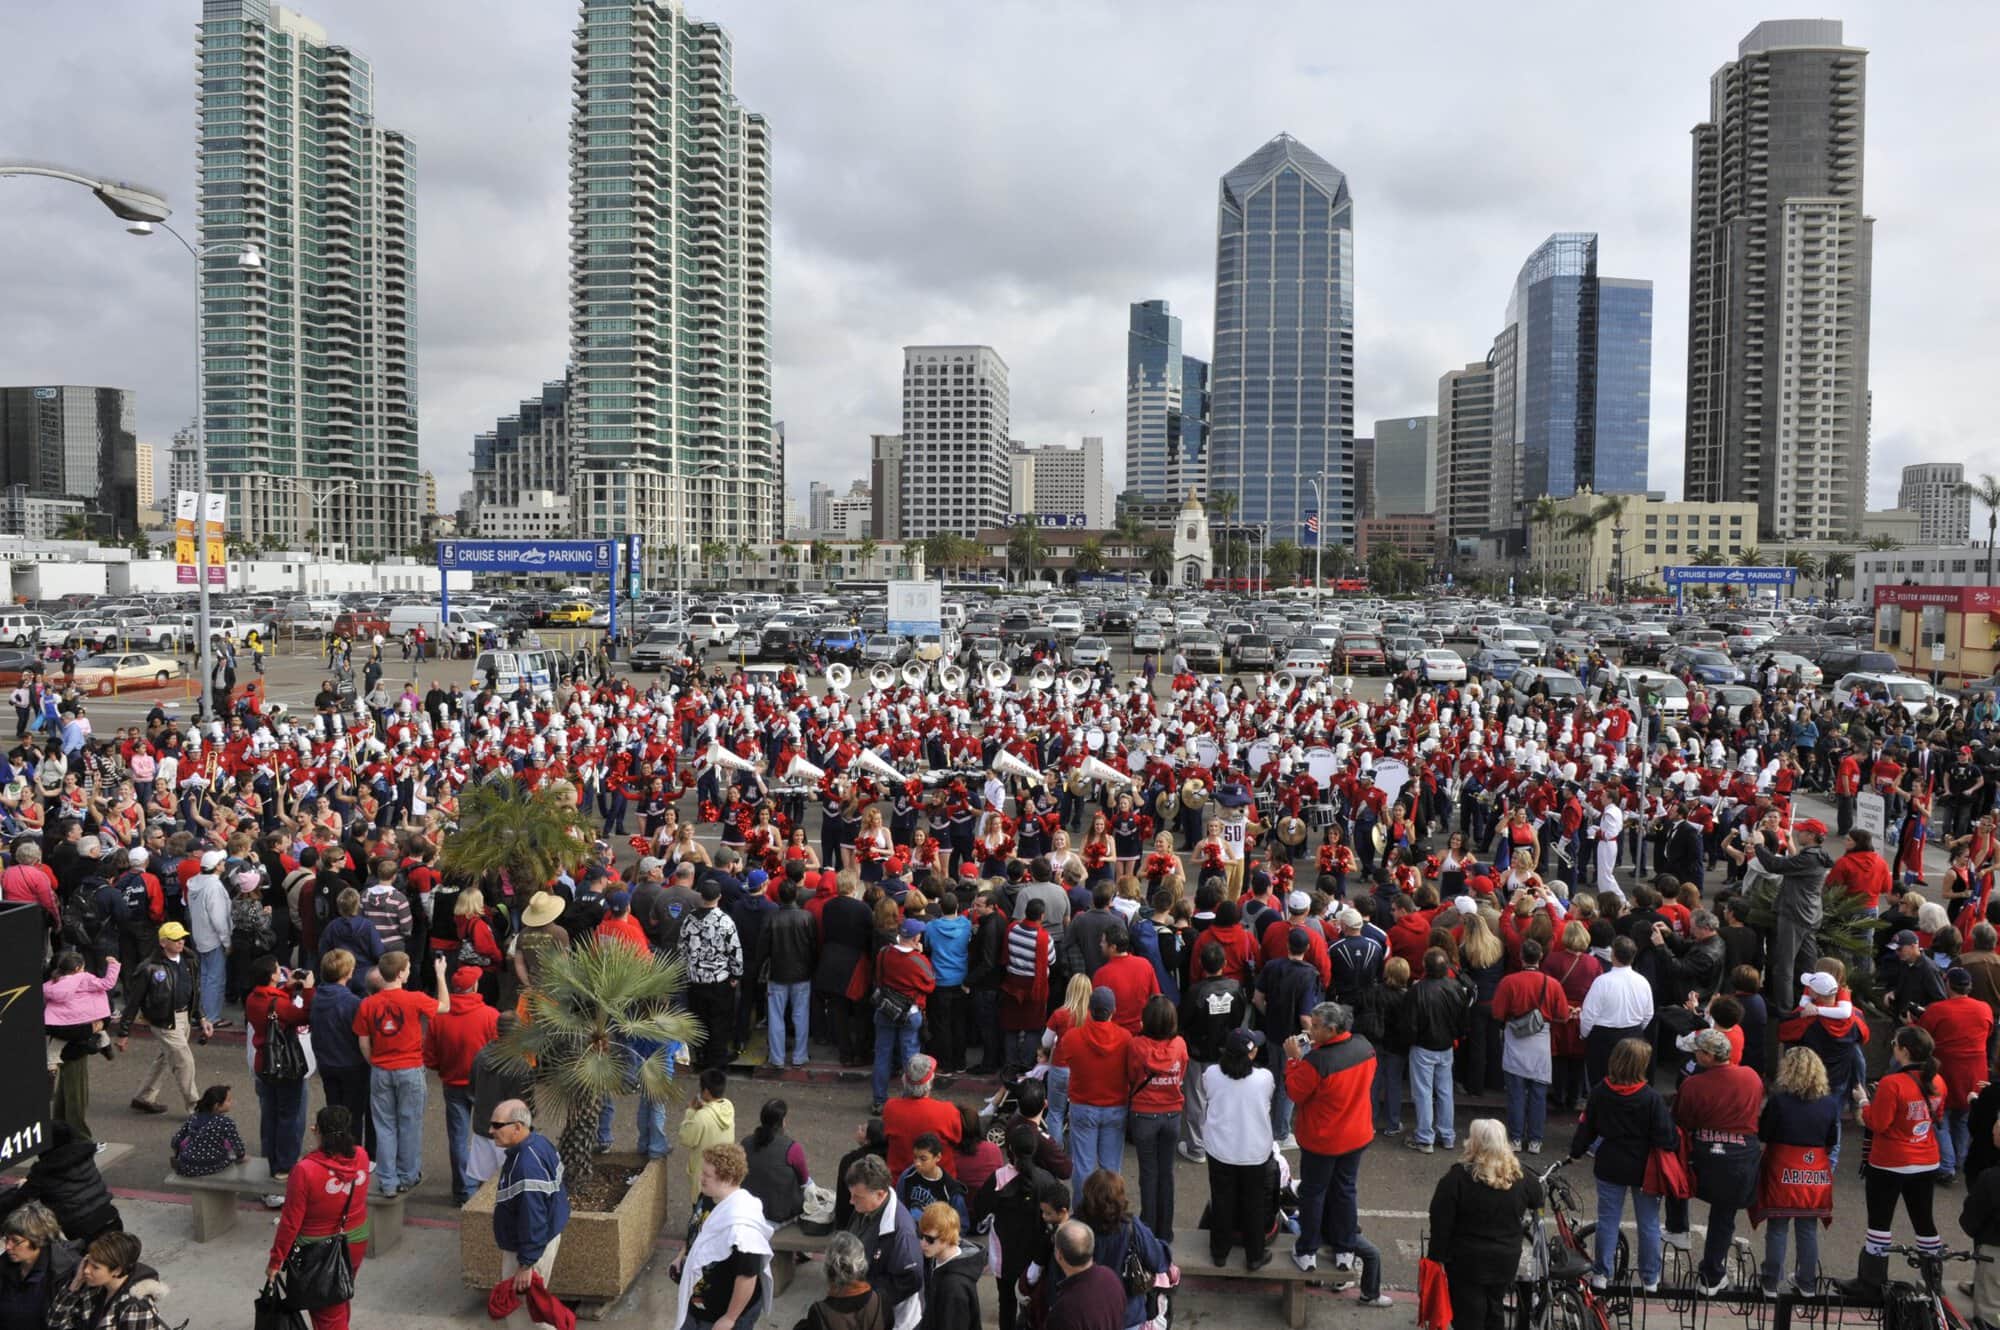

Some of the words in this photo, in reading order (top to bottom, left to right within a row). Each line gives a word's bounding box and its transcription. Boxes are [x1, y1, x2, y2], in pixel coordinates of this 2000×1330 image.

[1066, 514, 1085, 526] Fe
[458, 549, 495, 562] CRUISE
[497, 549, 520, 562] SHIP
[548, 549, 593, 562] PARKING
[1678, 571, 1707, 579] CRUISE
[1708, 571, 1727, 579] SHIP
[1747, 571, 1782, 580] PARKING
[632, 577, 639, 594] P
[1897, 593, 1919, 602] VISITOR
[1919, 593, 1959, 603] INFORMATION
[1224, 825, 1242, 841] 50
